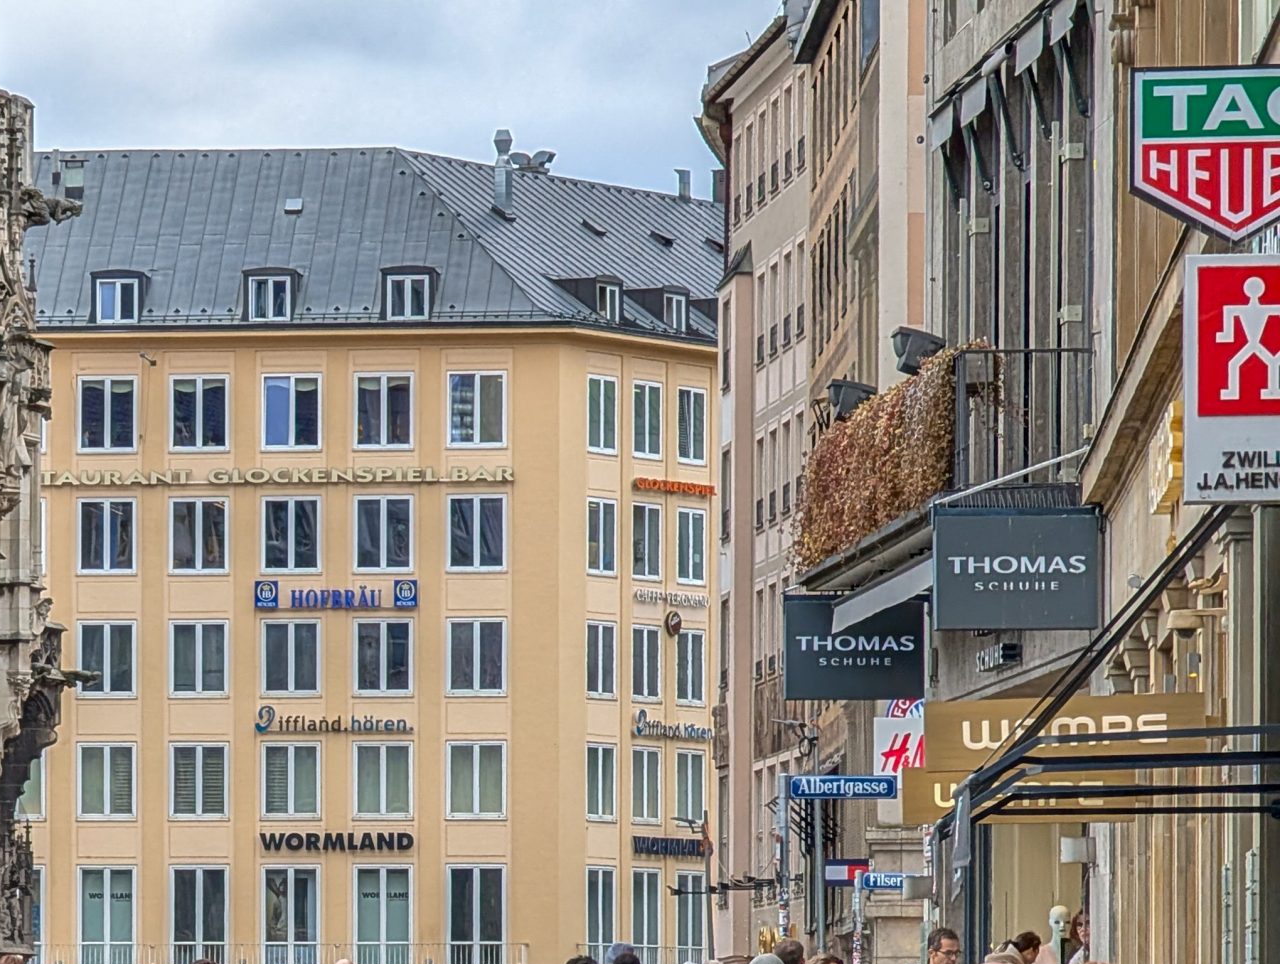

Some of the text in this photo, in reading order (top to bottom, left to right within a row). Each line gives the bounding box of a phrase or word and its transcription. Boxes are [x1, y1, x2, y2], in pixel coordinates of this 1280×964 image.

[1153, 84, 1280, 131] TA
[208, 466, 438, 484] GLOCKENSPIEL
[451, 466, 514, 482] BAR
[1197, 471, 1280, 491] J.A.HEN
[634, 477, 717, 496] GLOCKENSPIEL
[948, 555, 1087, 574] THOMAS
[974, 580, 1060, 591] SCHUHE
[291, 585, 382, 608] HOFBRÄU
[795, 635, 915, 651] THOMAS
[818, 657, 892, 666] SCHUHE
[798, 777, 888, 797] Albertgasse
[259, 832, 414, 852] WORMLAND
